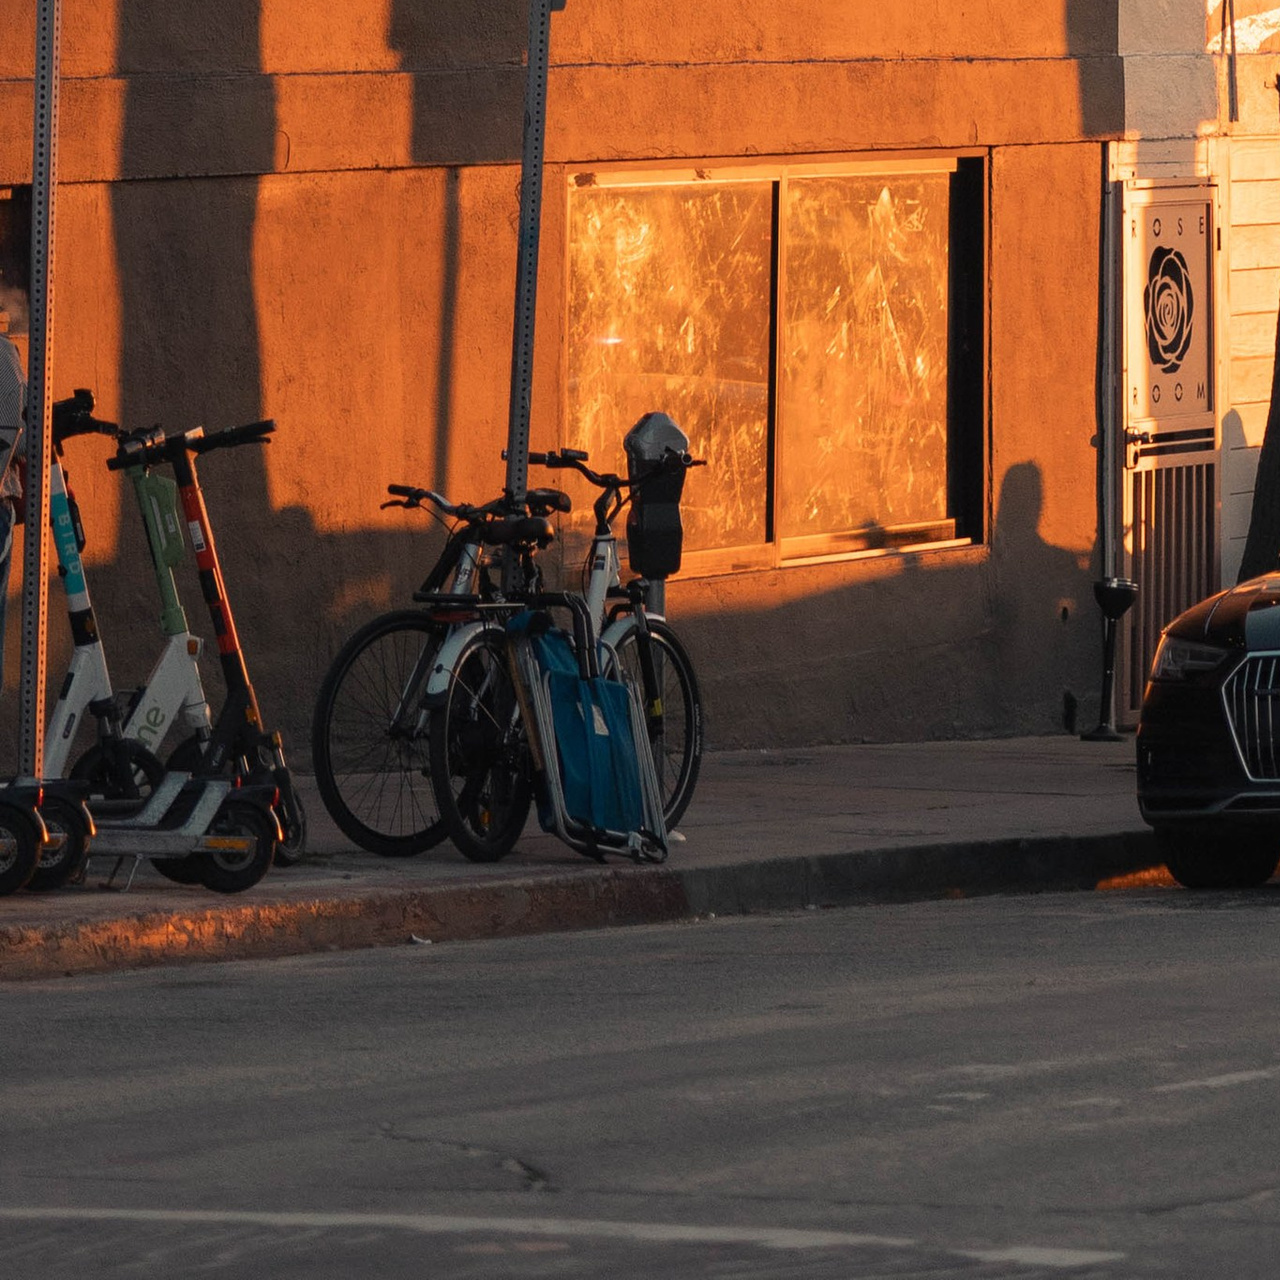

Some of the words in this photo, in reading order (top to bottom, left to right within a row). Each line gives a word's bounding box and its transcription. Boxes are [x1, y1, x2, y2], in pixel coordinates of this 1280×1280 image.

[1131, 216, 1204, 238] ROSE
[1133, 382, 1206, 405] ROOM
[58, 511, 80, 574] BIRD
